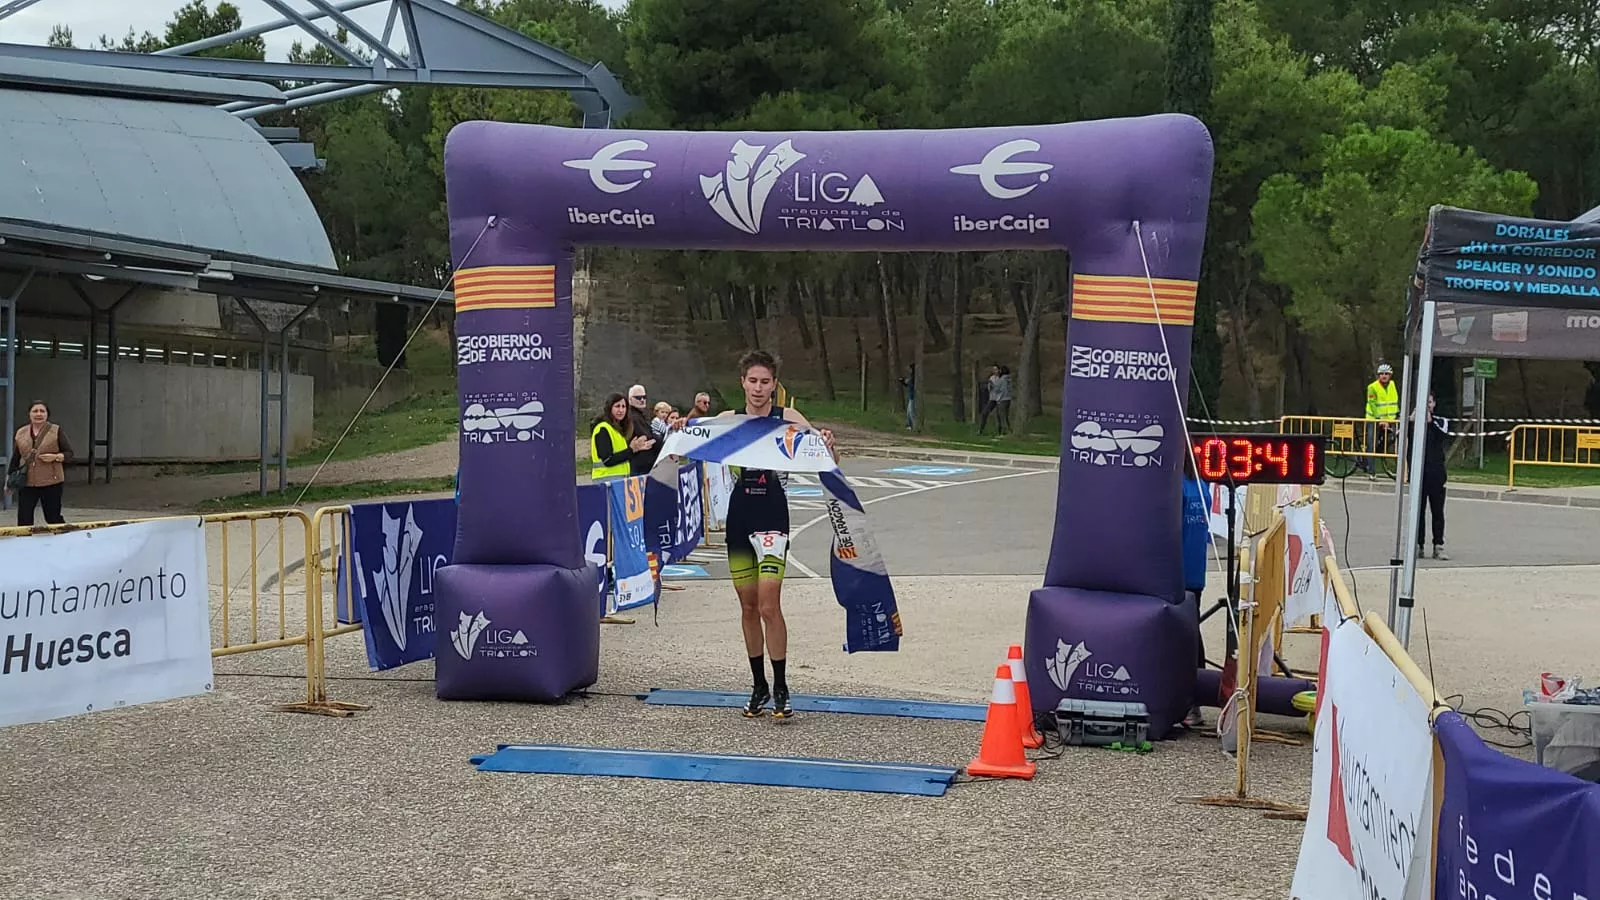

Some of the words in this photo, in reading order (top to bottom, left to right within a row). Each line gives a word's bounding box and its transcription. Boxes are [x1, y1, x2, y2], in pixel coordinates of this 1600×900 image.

[794, 172, 885, 206] LIGA
[568, 207, 655, 228] iberCaja
[778, 216, 905, 231] TRIATLON
[954, 214, 1049, 233] iberCaja
[1496, 223, 1569, 241] DORSALES
[1512, 246, 1596, 260] CORREDOR
[1456, 259, 1521, 274] SPEAKER
[1525, 263, 1534, 275] Y
[1537, 265, 1596, 279] SONIDO
[1445, 276, 1510, 292] TROFEOS
[1513, 281, 1524, 292] Y
[1527, 283, 1600, 297] MEDALLA
[470, 334, 542, 348] GOBIERNO
[471, 349, 486, 362] DE
[490, 347, 552, 361] ARAGON
[1091, 349, 1170, 366] GOBIERNO
[1090, 364, 1110, 378] DE
[1113, 365, 1177, 381] ARAGON
[463, 429, 545, 444] TRIATLON
[1070, 448, 1162, 467] TRIATLON
[763, 536, 774, 548] 8
[1, 566, 187, 620] untamiento
[486, 629, 529, 645] LIGA
[3, 628, 131, 675] Huesca
[1086, 662, 1131, 681] LIGA
[1077, 682, 1140, 695] TRIATLON
